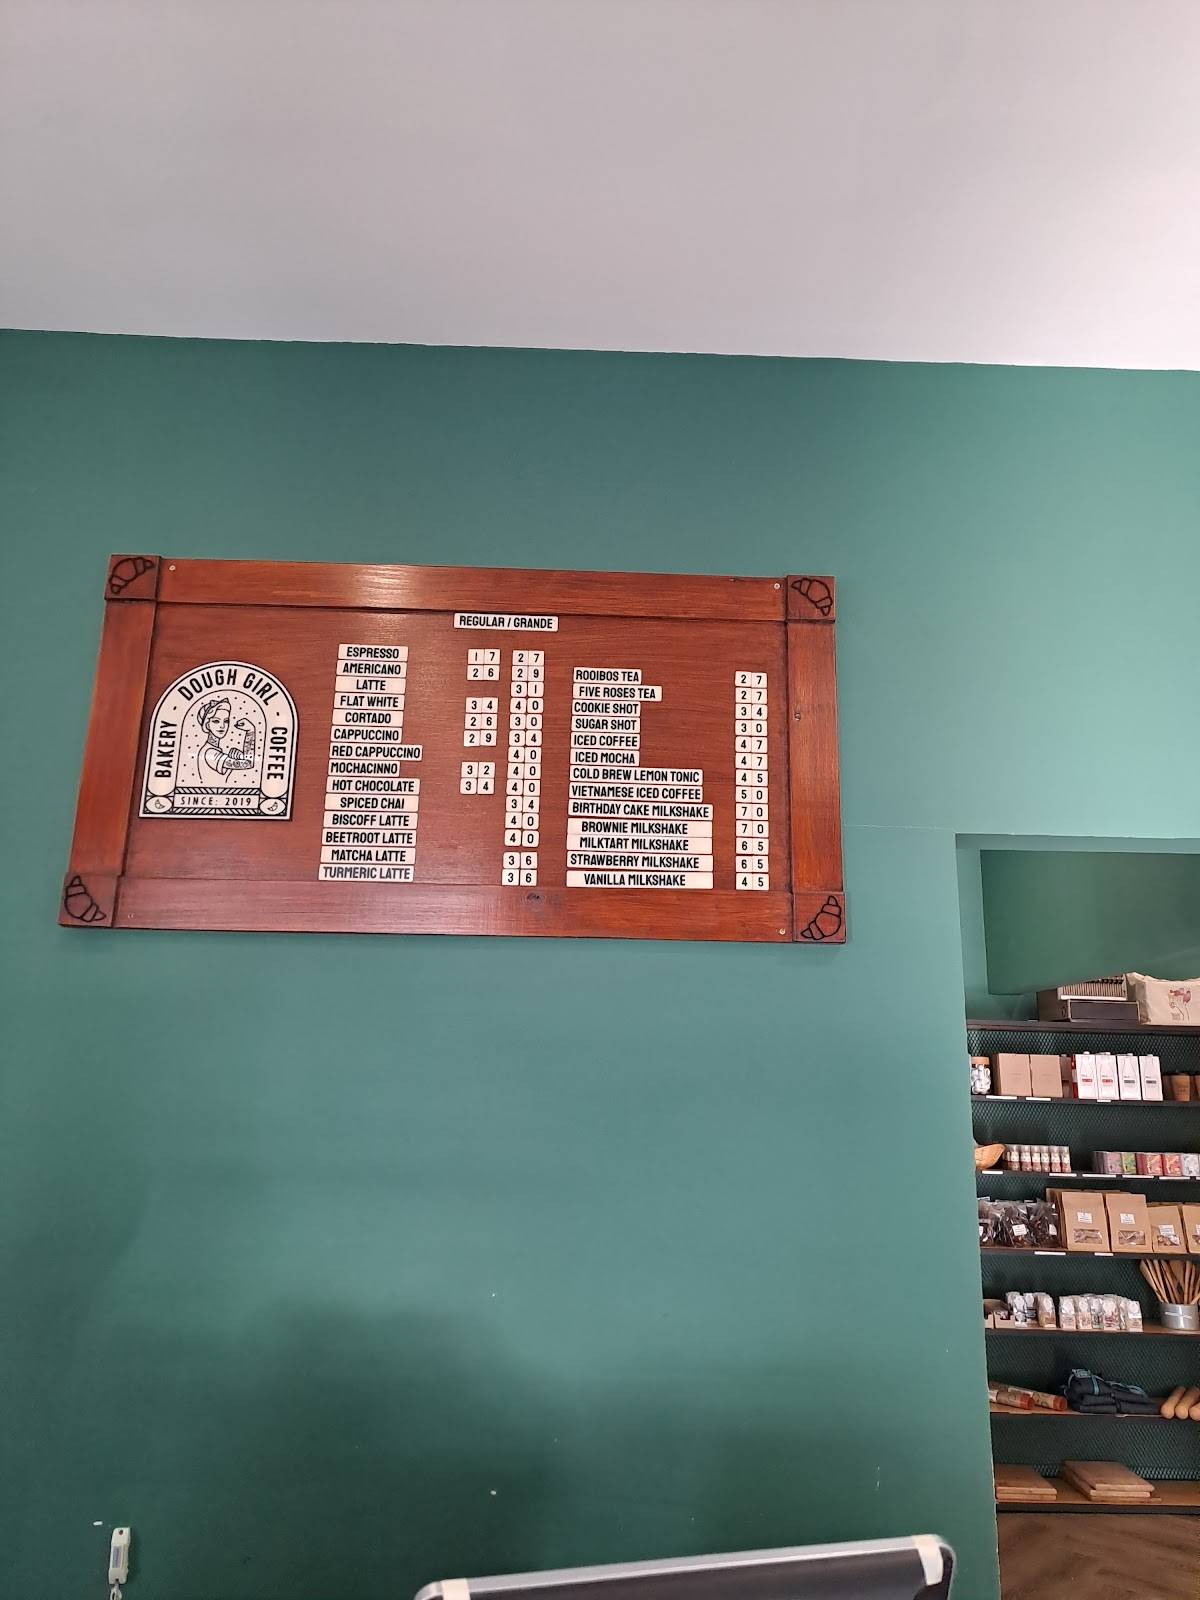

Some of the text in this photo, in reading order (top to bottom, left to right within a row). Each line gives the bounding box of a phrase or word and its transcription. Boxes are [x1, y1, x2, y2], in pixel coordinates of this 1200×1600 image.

[460, 616, 505, 628] REGULAR
[513, 617, 553, 628] GRANDE
[347, 647, 399, 659] ESPRESSO
[343, 663, 401, 674] AMERICANO
[576, 670, 639, 682] ROOIBOS TEA
[178, 669, 278, 705] DOUGH GIRL
[356, 680, 386, 691] LATTE
[579, 687, 656, 699] FIVE ROSES TEA
[340, 695, 399, 708] FLAT WHITE
[574, 702, 638, 714] COOKIE SHOT
[345, 712, 391, 724] CORTADO
[575, 719, 637, 730] SUGAR SHOT
[334, 729, 399, 741] CAPPUCCINO
[574, 735, 637, 747] ICED COFFEE
[154, 720, 177, 777] BAKERY
[267, 727, 287, 780] COFFEE
[332, 745, 420, 759] RED CAPPUCCINO
[575, 752, 635, 764] ICED MOCHA
[331, 763, 398, 774] MOCHACINNO
[573, 768, 699, 782] COLD BREW LEMON TONIC
[332, 780, 414, 792] HOT CHOCOLATE
[572, 786, 700, 800] VIETNAMESE ICED COFFEE
[225, 798, 251, 806] 2019
[340, 797, 405, 809] SPICED CHAI
[573, 802, 709, 818] BIRTHDAY CAKE MILKSHAKE
[332, 814, 410, 827] BISCOFF LATTE
[582, 821, 688, 834] BROWNIE MILKSHAKE
[325, 832, 413, 844] BEETROOT LATTE
[579, 837, 689, 850] MILKTART MILKSHAKE
[331, 850, 406, 862] MATCHA LATTE
[570, 854, 699, 868] STRAWBERRY MILKSHAKE
[323, 867, 410, 880] TURMERIC LATTE
[584, 874, 685, 886] VANILLA MILKSHAKE
